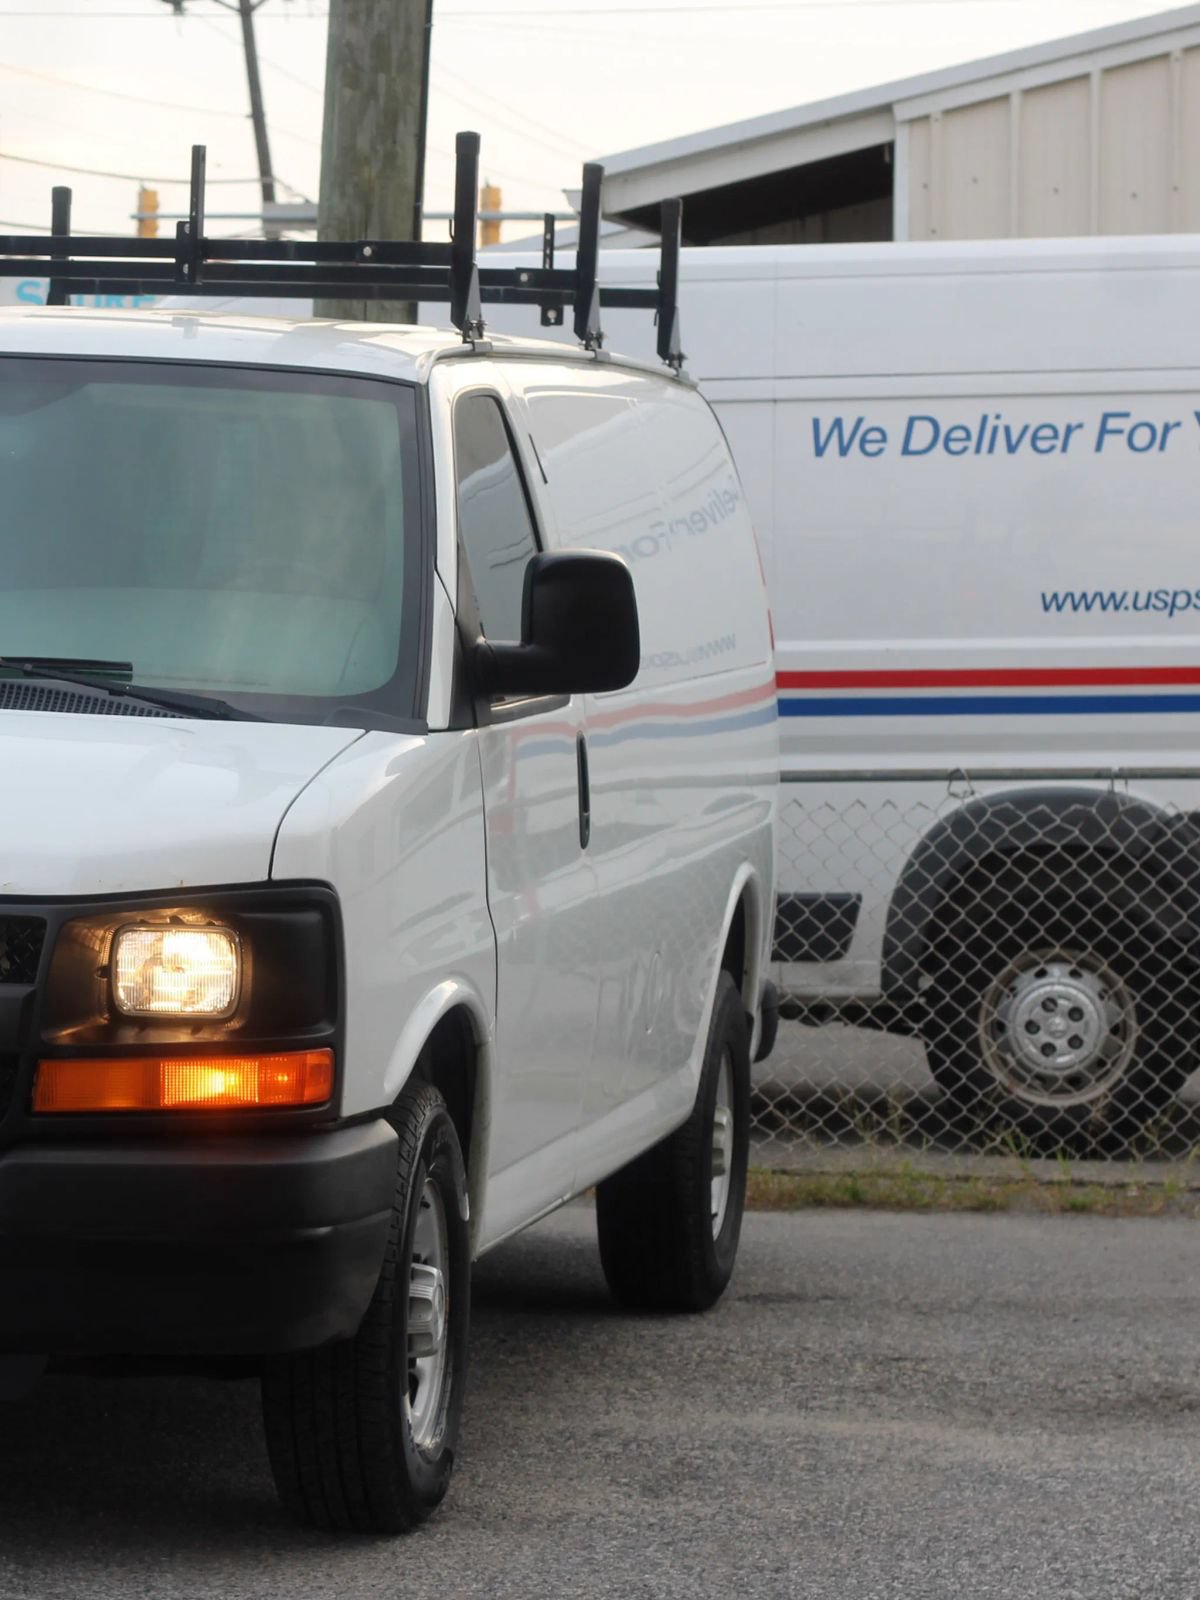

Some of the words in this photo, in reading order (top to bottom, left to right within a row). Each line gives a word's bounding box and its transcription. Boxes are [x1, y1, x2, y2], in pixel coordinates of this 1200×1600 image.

[811, 416, 887, 458] We
[901, 413, 1084, 456] Deliver
[1094, 411, 1182, 453] For
